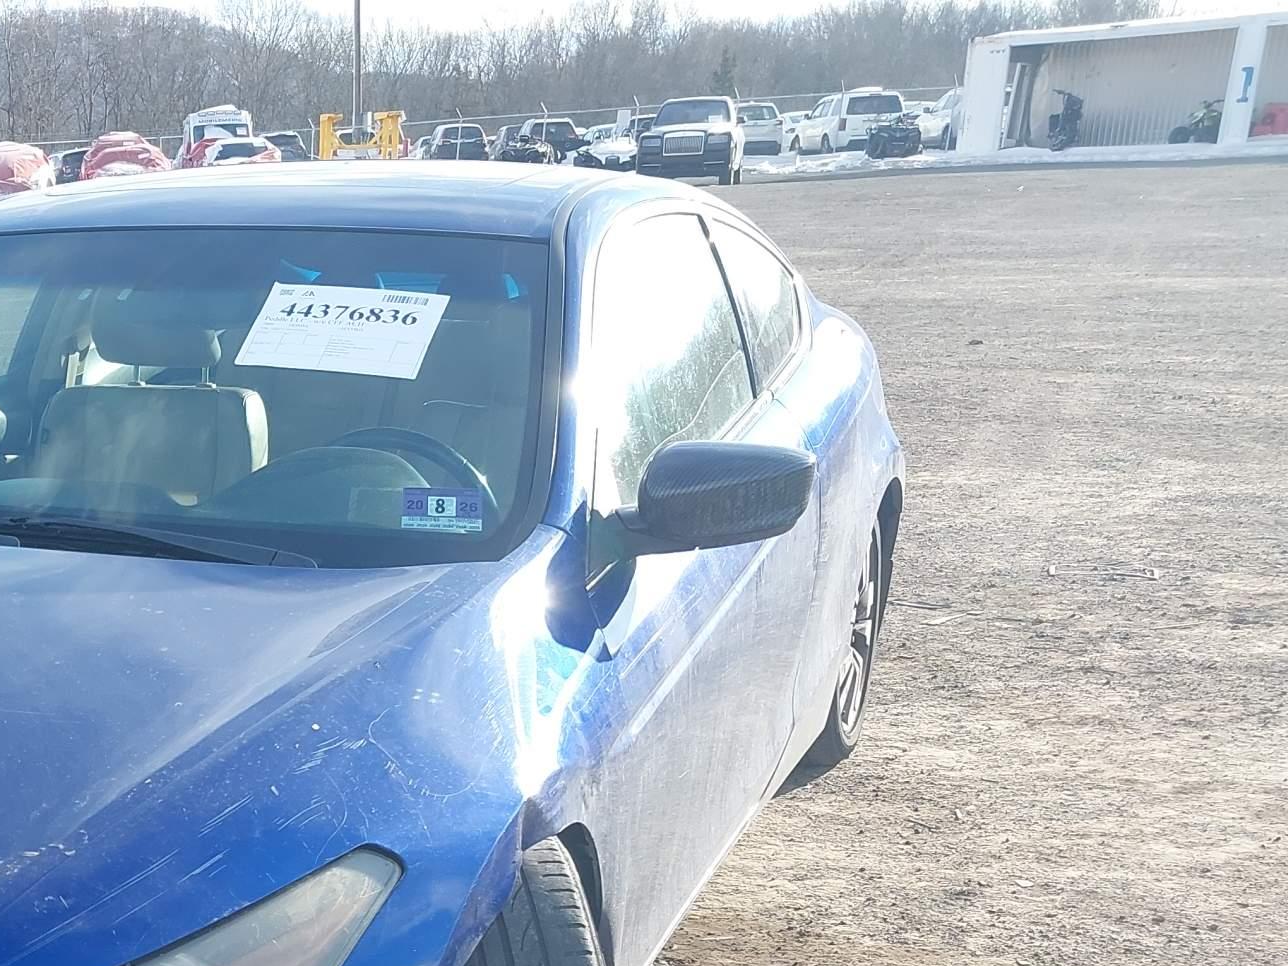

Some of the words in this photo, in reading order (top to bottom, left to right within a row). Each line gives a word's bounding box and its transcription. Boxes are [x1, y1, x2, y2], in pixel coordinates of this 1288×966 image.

[279, 302, 421, 325] 44376836
[407, 499, 423, 510] 20
[435, 498, 446, 514] 8
[459, 502, 478, 512] 26
